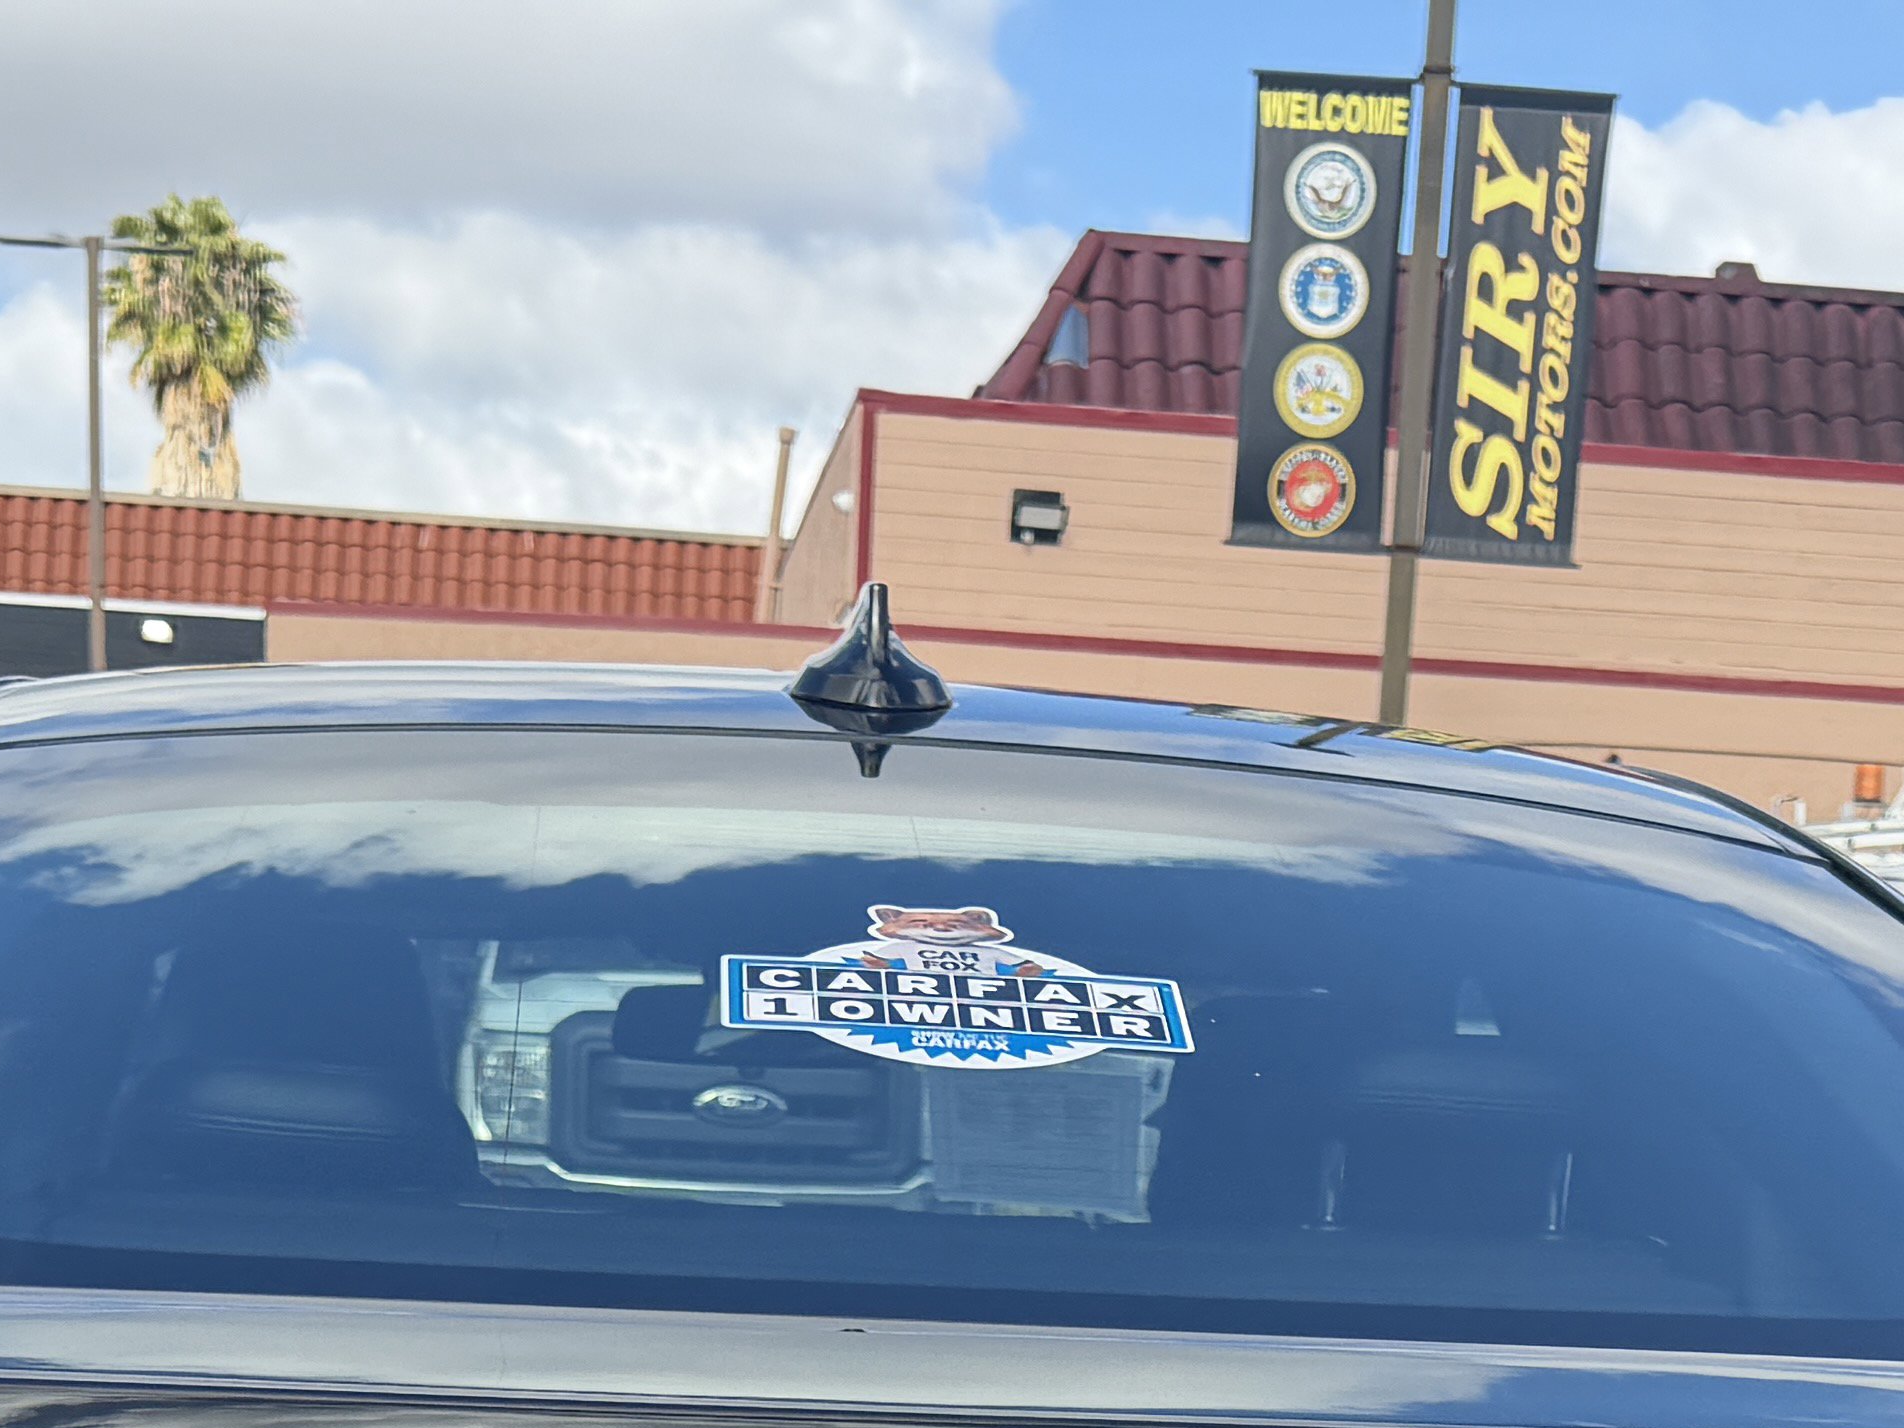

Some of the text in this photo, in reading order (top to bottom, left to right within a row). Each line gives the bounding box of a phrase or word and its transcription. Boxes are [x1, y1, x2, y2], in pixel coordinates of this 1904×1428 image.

[1260, 89, 1410, 136] WELCOME
[1449, 106, 1548, 541] SIRY
[1525, 114, 1591, 541] MOTORS.COM
[918, 950, 979, 962] CAR
[923, 961, 981, 972] FOX
[759, 967, 1160, 1012] CARFAX
[763, 995, 1153, 1038] 1 OWNER
[911, 1037, 1011, 1051] CARFAX
